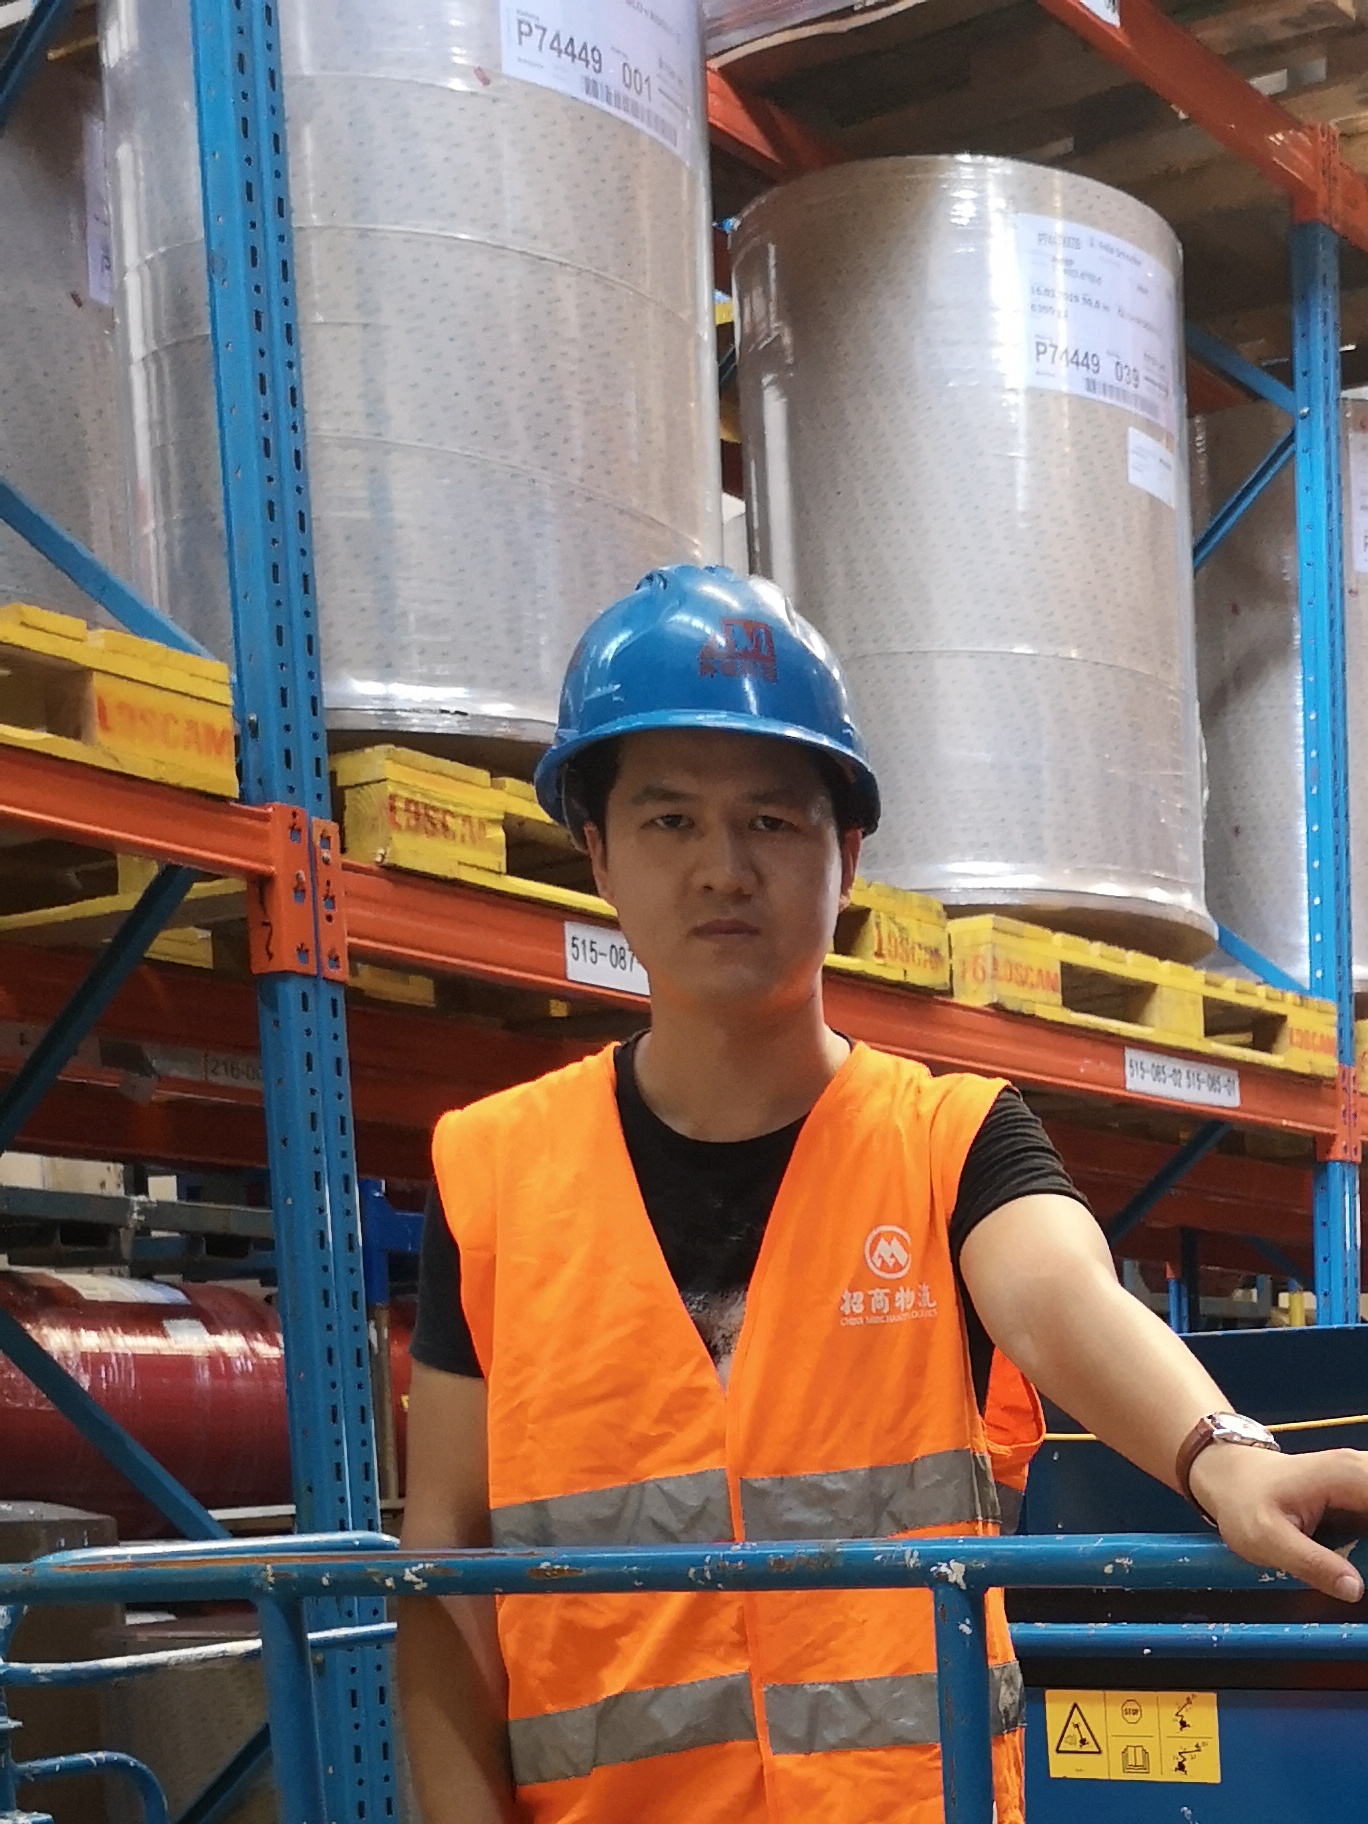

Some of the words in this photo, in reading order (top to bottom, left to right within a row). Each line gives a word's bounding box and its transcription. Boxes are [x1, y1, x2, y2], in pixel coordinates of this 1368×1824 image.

[516, 18, 603, 74] P74449
[622, 62, 652, 103] 001
[1034, 340, 1101, 375] P74449
[1123, 1707, 1140, 1716] STOP
